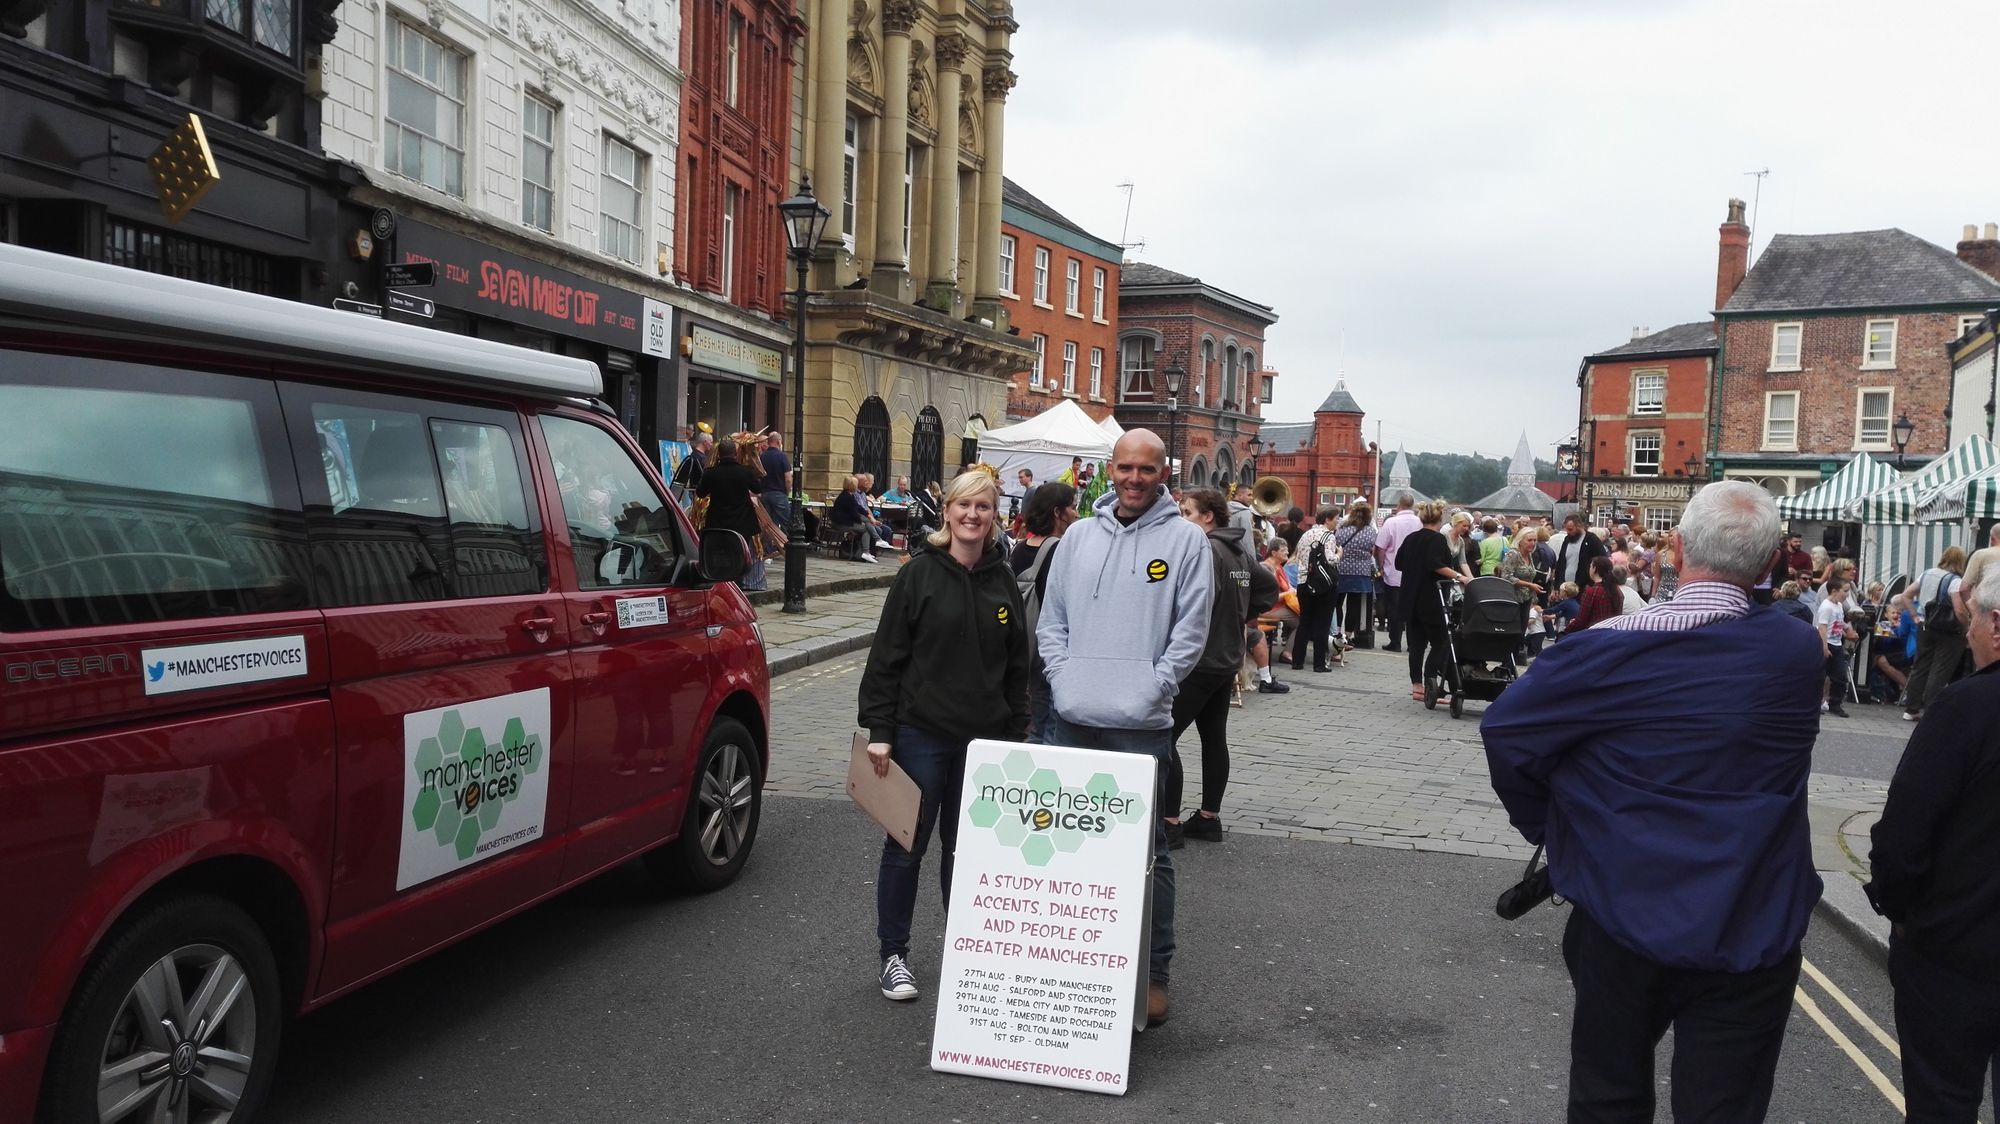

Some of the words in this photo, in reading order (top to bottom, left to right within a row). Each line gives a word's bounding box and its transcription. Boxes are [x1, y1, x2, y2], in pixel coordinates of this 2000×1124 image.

[446, 264, 469, 284] FILM
[478, 260, 530, 309] SEVEN
[574, 290, 600, 326] OUT
[604, 310, 616, 325] ART
[620, 315, 636, 330] CAFE
[650, 324, 664, 338] OLD
[694, 331, 725, 353] CHESHIRE
[726, 341, 740, 358] USED
[1625, 483, 1658, 498] HEAD
[6, 653, 129, 682] OCEAN
[168, 648, 301, 677] #MANCHESTERVOICES
[424, 738, 536, 793] manchester
[981, 784, 1134, 815] manchester
[476, 825, 538, 855] MANCHESTERVOICES.ORG
[979, 873, 989, 886] A
[994, 874, 1044, 891] STUDY
[1048, 880, 1082, 896] INTO
[1088, 884, 1117, 900] THE
[972, 894, 1042, 916] ACCENTS,
[1050, 902, 1118, 923] DIALECTS
[984, 918, 1015, 933] AND
[1020, 922, 1077, 940] PEOPLE
[1082, 929, 1102, 943] OF
[954, 938, 1022, 957] GREATER
[1028, 945, 1128, 970] MANCHESTER
[958, 980, 980, 989] 28TH
[982, 983, 1000, 992] AUG
[1010, 986, 1046, 998] SALFORD
[1048, 991, 1065, 1000] AND
[1068, 994, 1116, 1006] STOCKPORT
[964, 968, 986, 978] 27TH
[988, 972, 1005, 980] AUG
[1016, 974, 1038, 984] BURY
[1040, 978, 1057, 986] AND
[1059, 980, 1112, 993] MANCHESTER
[956, 992, 977, 1000] 29TH
[979, 995, 996, 1004] AUG
[1006, 998, 1030, 1008] MEDIA
[1032, 1001, 1050, 1010] CITY
[1053, 1004, 1070, 1012] AND
[1073, 1006, 1117, 1018] TRAFFORD
[958, 1004, 980, 1013] 30TH
[982, 1008, 999, 1016] AUG
[1010, 1010, 1048, 1022] TAMESIDE
[1050, 1016, 1068, 1024] AND
[1070, 1018, 1113, 1030] ROCHDALE
[970, 1018, 988, 1026] 31ST
[990, 1020, 1007, 1030] AUG
[1017, 1024, 1049, 1034] BOLTON
[1052, 1028, 1069, 1037] AND
[1072, 1030, 1098, 1040] WIGAN
[994, 1032, 1007, 1041] 1ST
[1010, 1034, 1025, 1043] SEP
[1034, 1038, 1070, 1050] OLDHAM
[938, 1050, 1122, 1084] WWW.MANCHESTERVOICES.ORG
